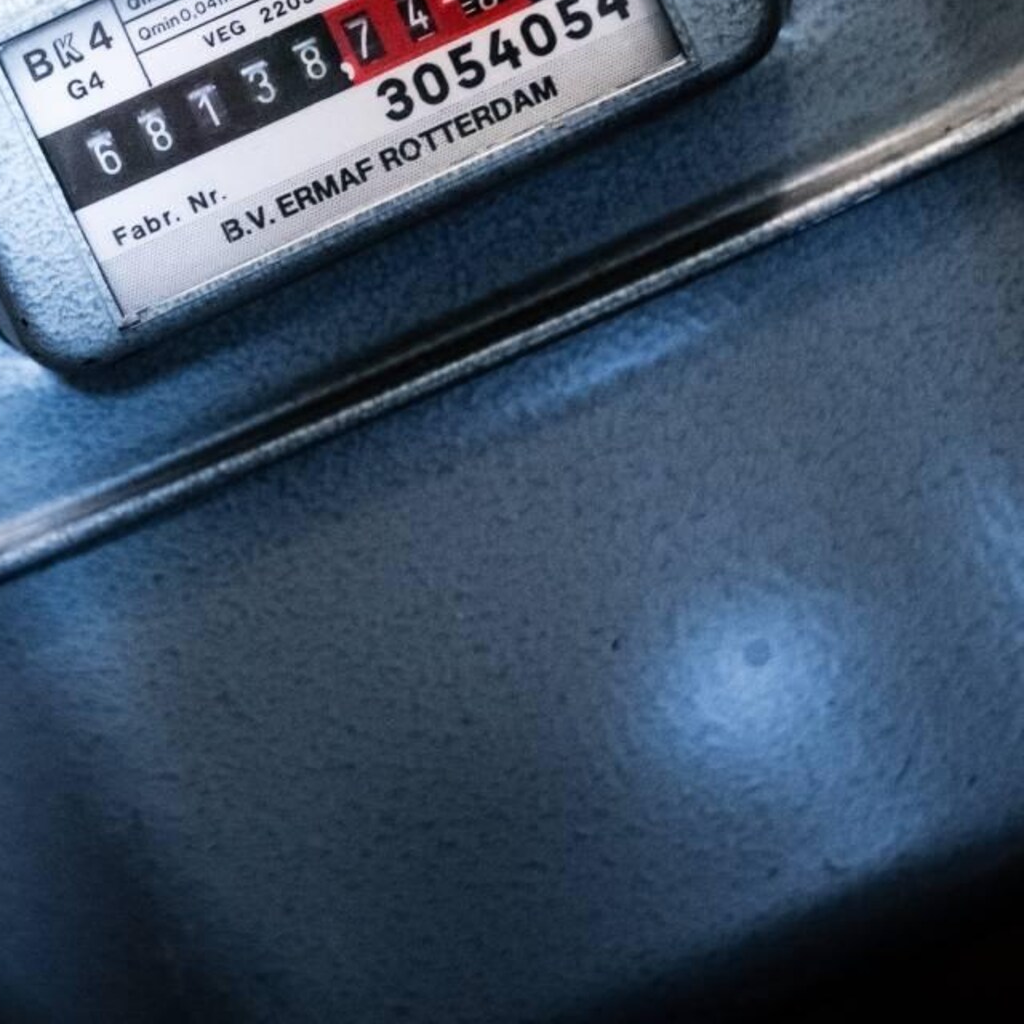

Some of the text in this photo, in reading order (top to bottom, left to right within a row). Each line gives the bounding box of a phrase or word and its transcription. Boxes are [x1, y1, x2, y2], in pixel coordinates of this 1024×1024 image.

[202, 20, 247, 48] VEG
[67, 70, 105, 100] G4
[220, 75, 560, 244] B.V. ERMAF ROTTERDAM
[112, 209, 181, 247] Fabr.
[187, 187, 228, 215] Nr.
